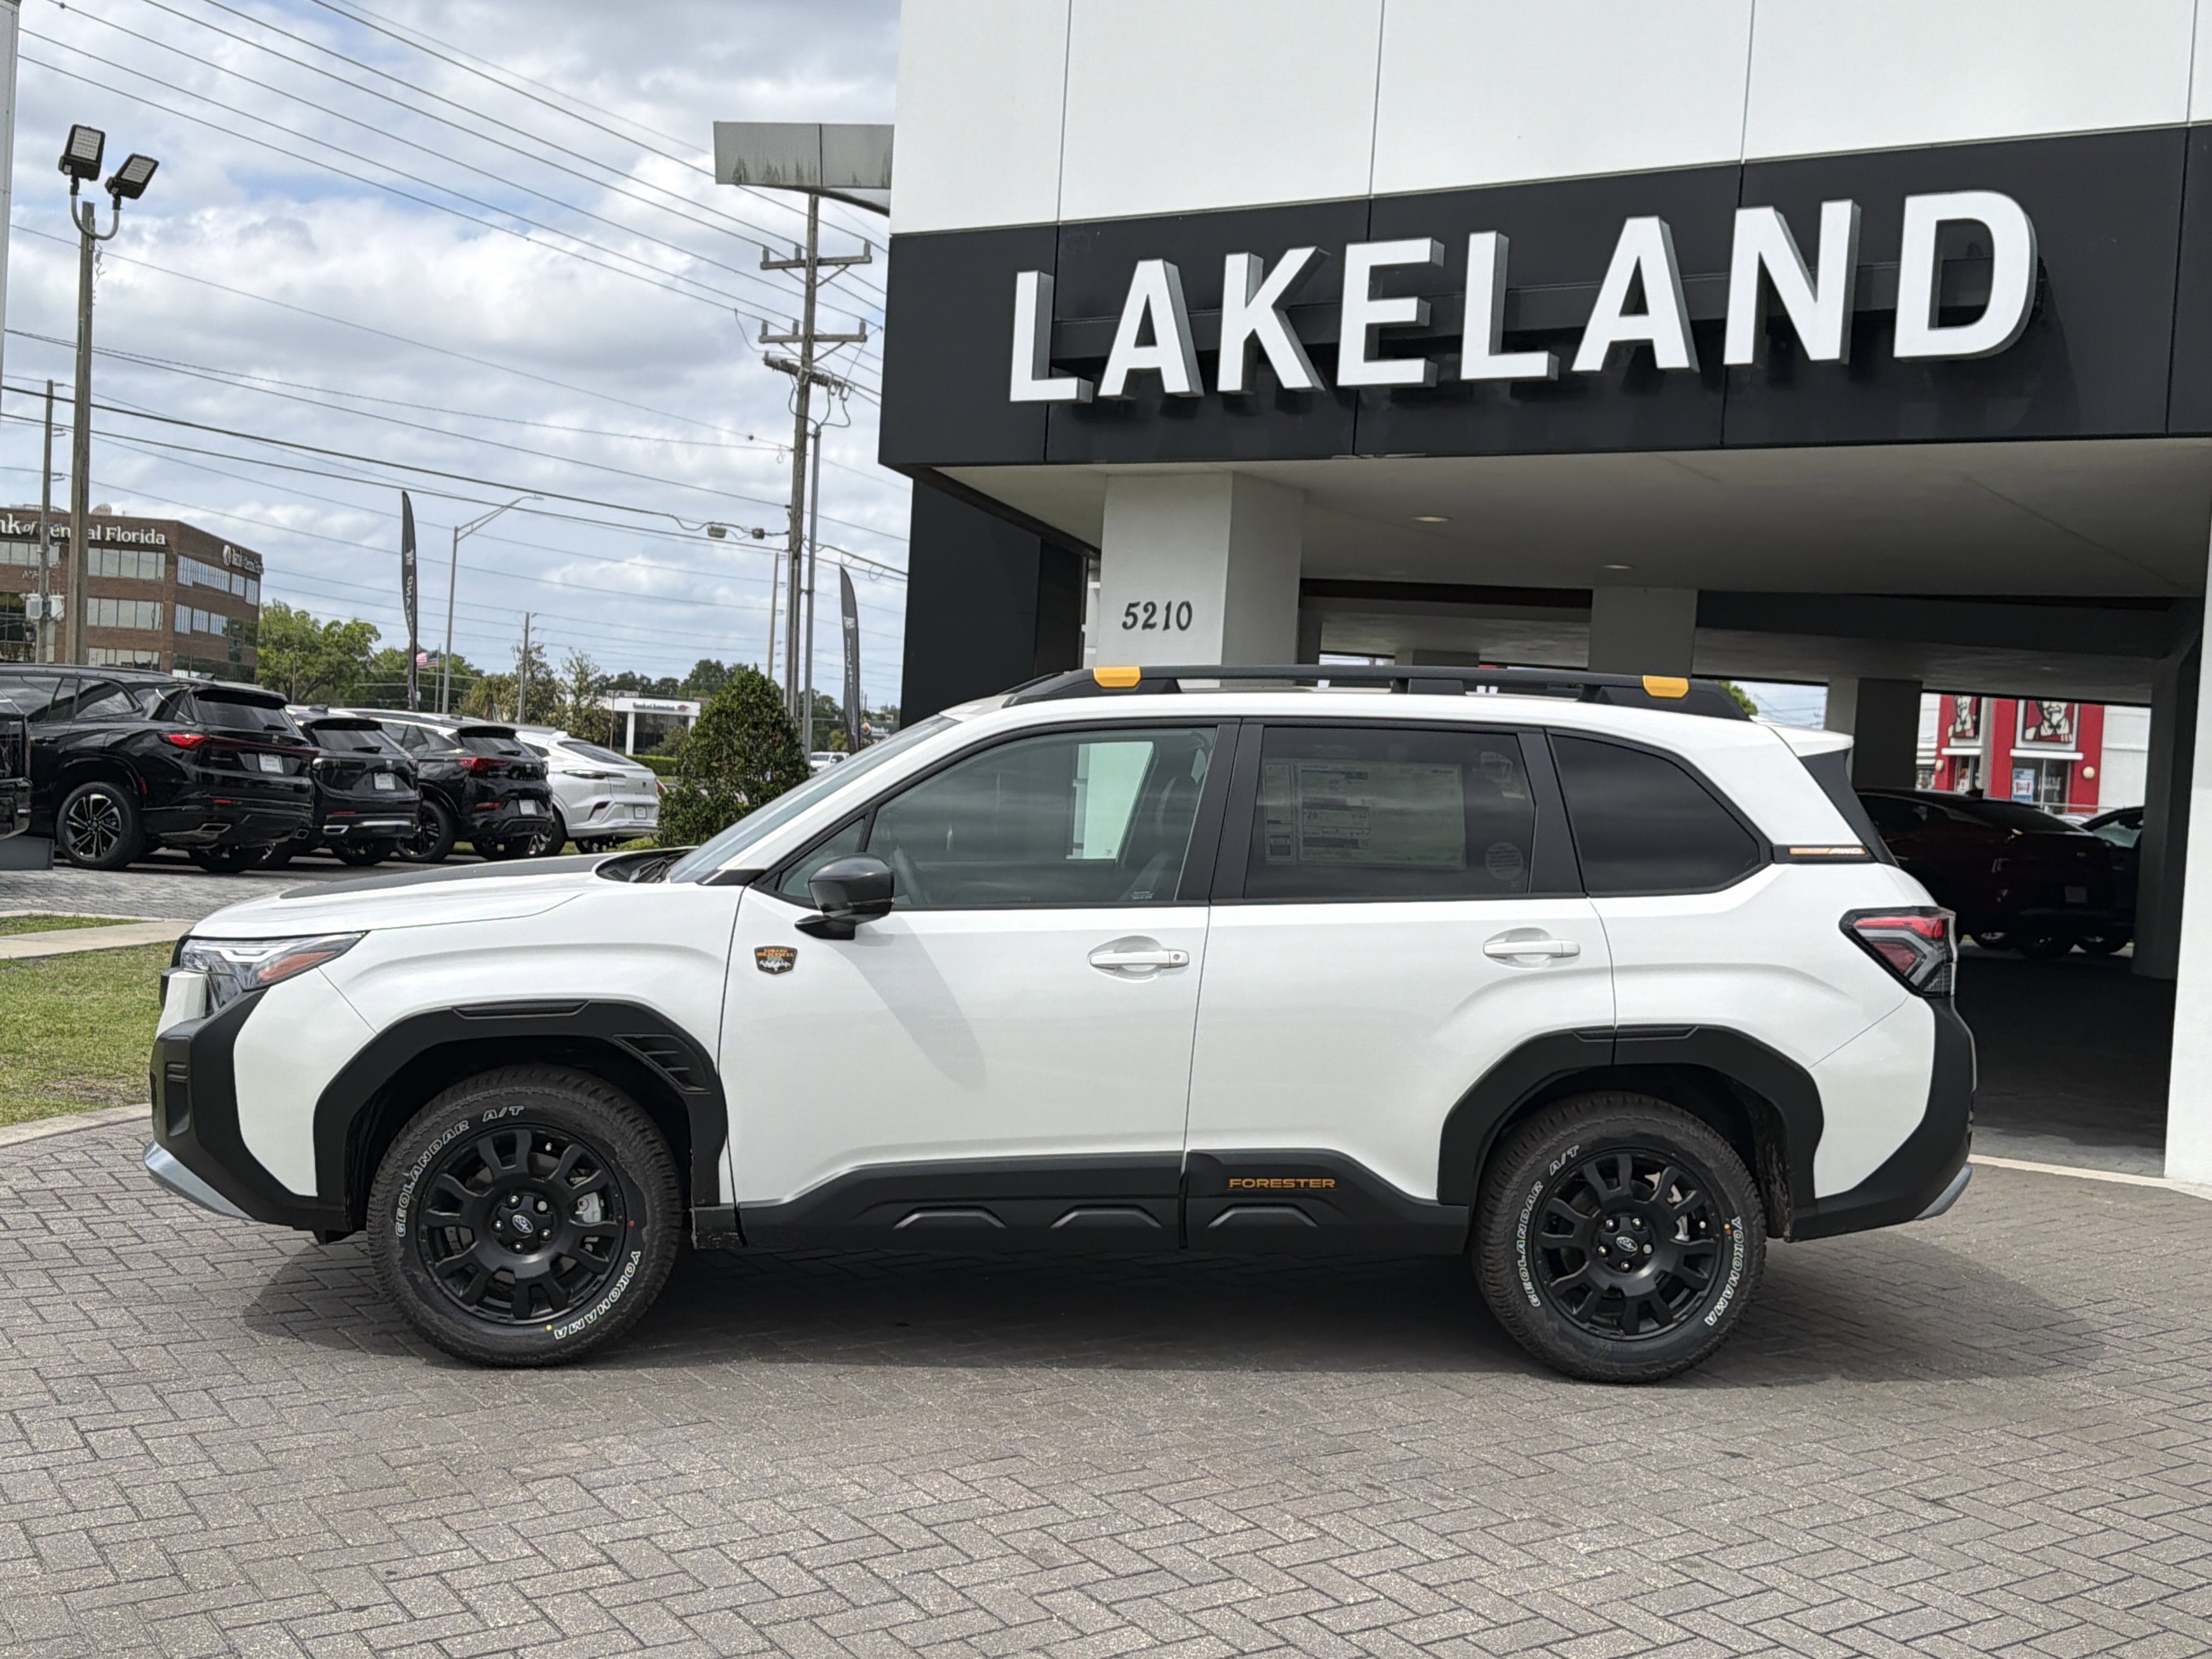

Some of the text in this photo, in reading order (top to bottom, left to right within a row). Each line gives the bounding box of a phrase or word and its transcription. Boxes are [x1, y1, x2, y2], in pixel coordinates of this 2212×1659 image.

[1010, 190, 2037, 404] LAKELAND
[22, 521, 37, 536] of
[40, 523, 101, 541] enal
[105, 526, 166, 545] Florida
[1122, 601, 1193, 631] 5210
[395, 1105, 524, 1237] GEOLANDAR A/T
[1229, 1178, 1336, 1189] FORESTER
[1516, 1144, 1579, 1307] GEOLANDAR A/T
[1704, 1216, 1744, 1326] YOKOHAMA
[554, 1250, 641, 1340] YOKOHAMA
